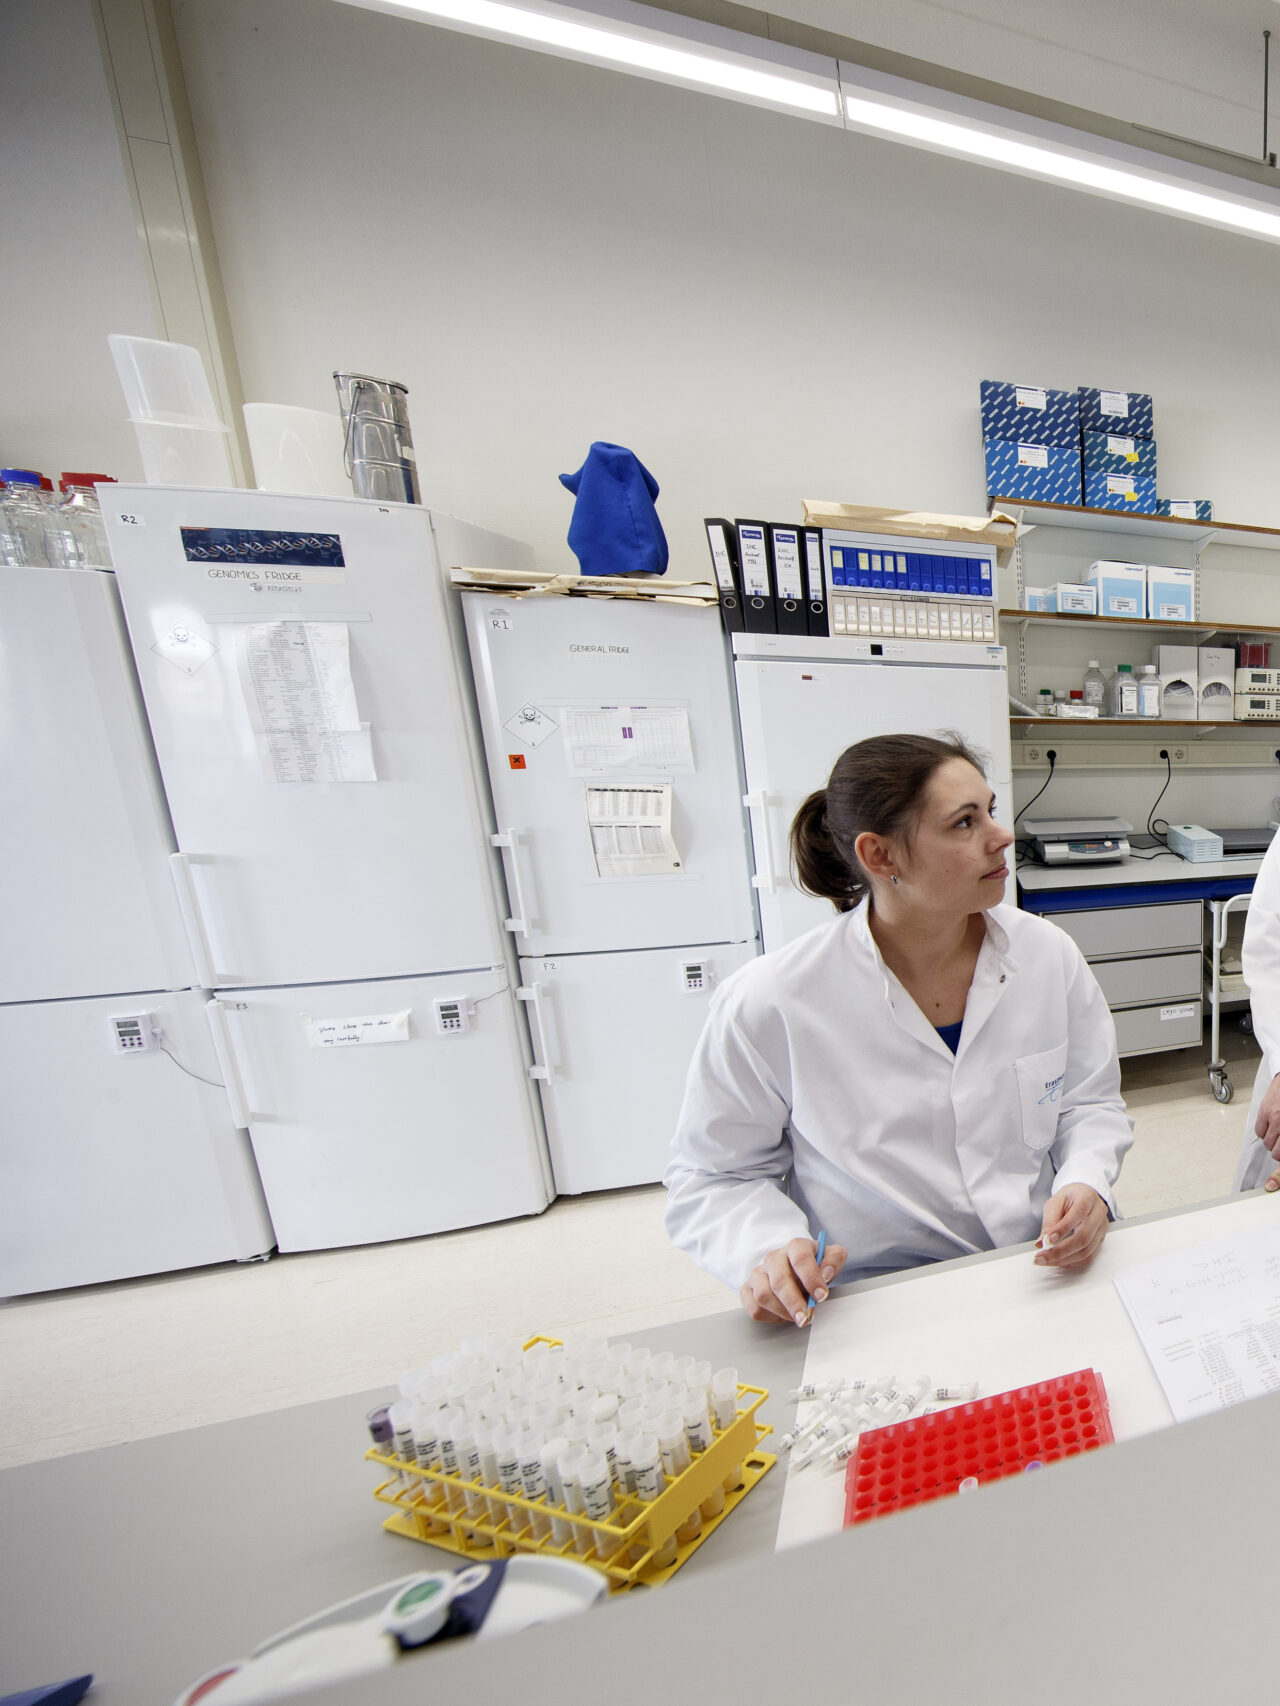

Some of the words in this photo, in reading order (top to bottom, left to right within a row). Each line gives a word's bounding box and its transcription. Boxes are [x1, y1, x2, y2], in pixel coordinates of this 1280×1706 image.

[121, 514, 138, 525] R2
[208, 569, 260, 580] GENOMICS
[264, 571, 302, 581] FRIDGE
[492, 619, 510, 630] R1
[569, 644, 607, 654] GENERAL
